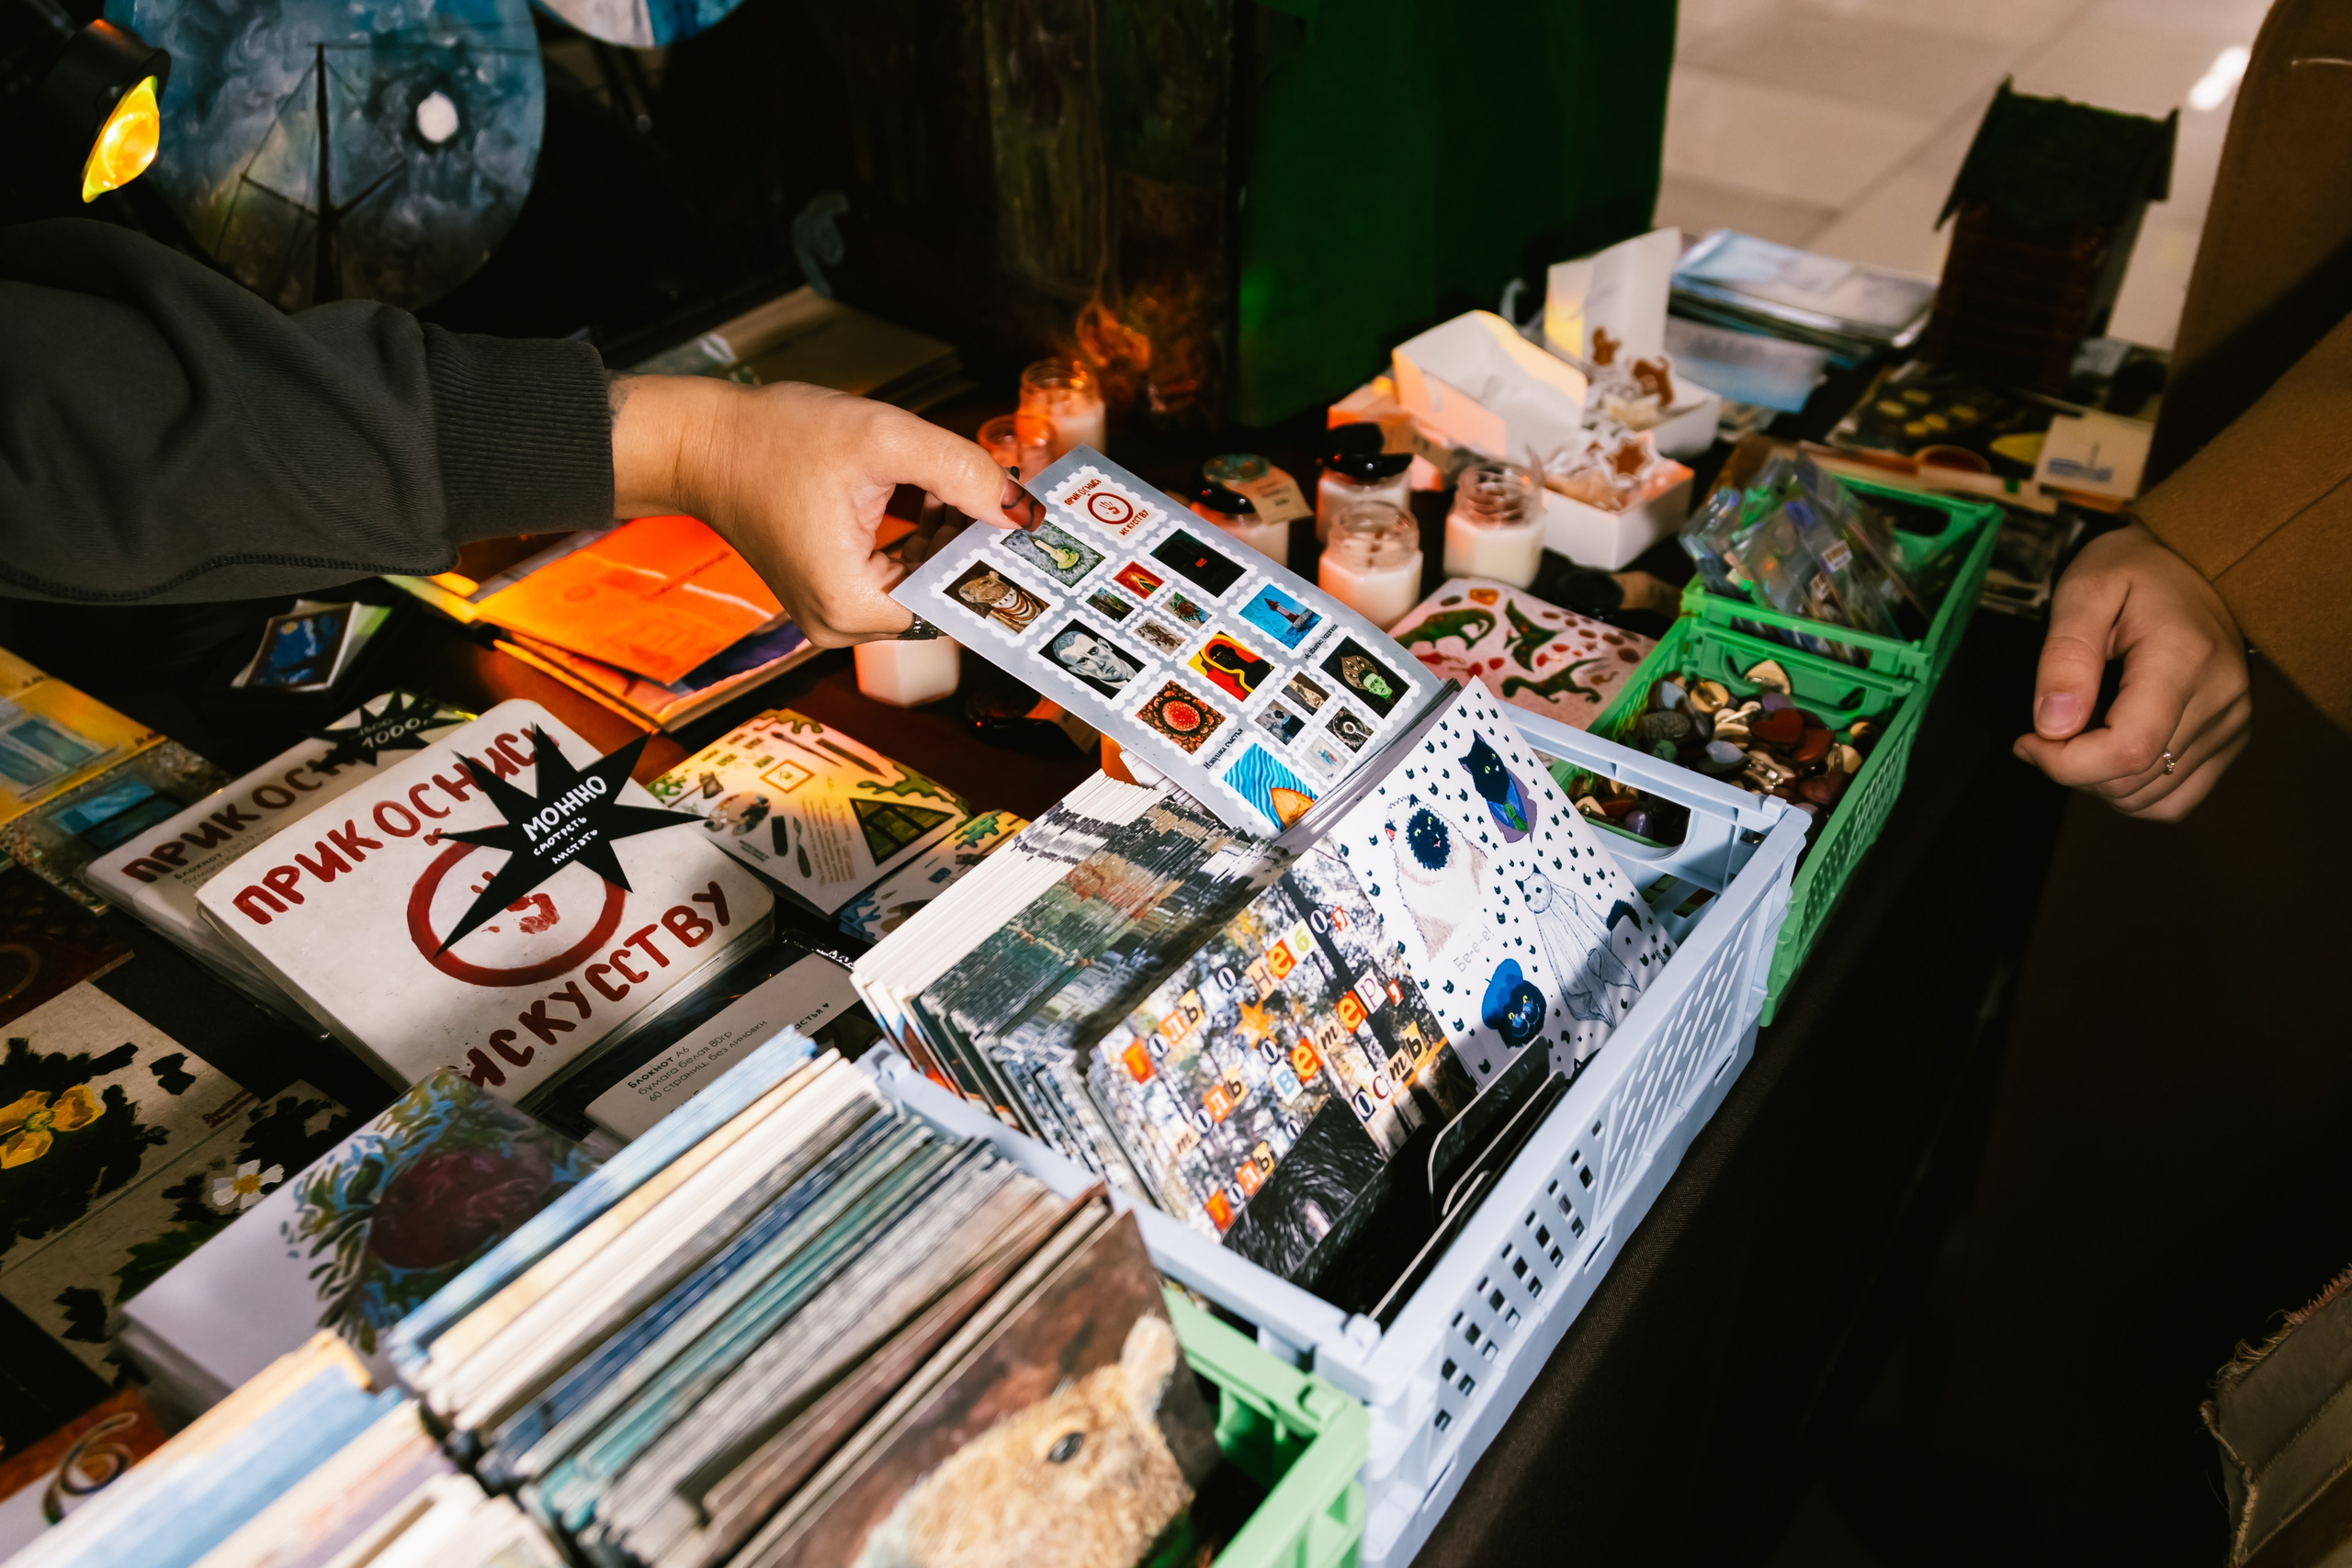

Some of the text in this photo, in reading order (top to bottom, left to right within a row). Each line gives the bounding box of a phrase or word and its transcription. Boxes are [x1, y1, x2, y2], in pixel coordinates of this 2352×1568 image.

[522, 775, 607, 842] МОЖНО
[638, 1031, 733, 1095] бумага белая 80гр
[649, 1090, 662, 1102] 60
[707, 1047, 729, 1061] без
[729, 1021, 768, 1048] линовки
